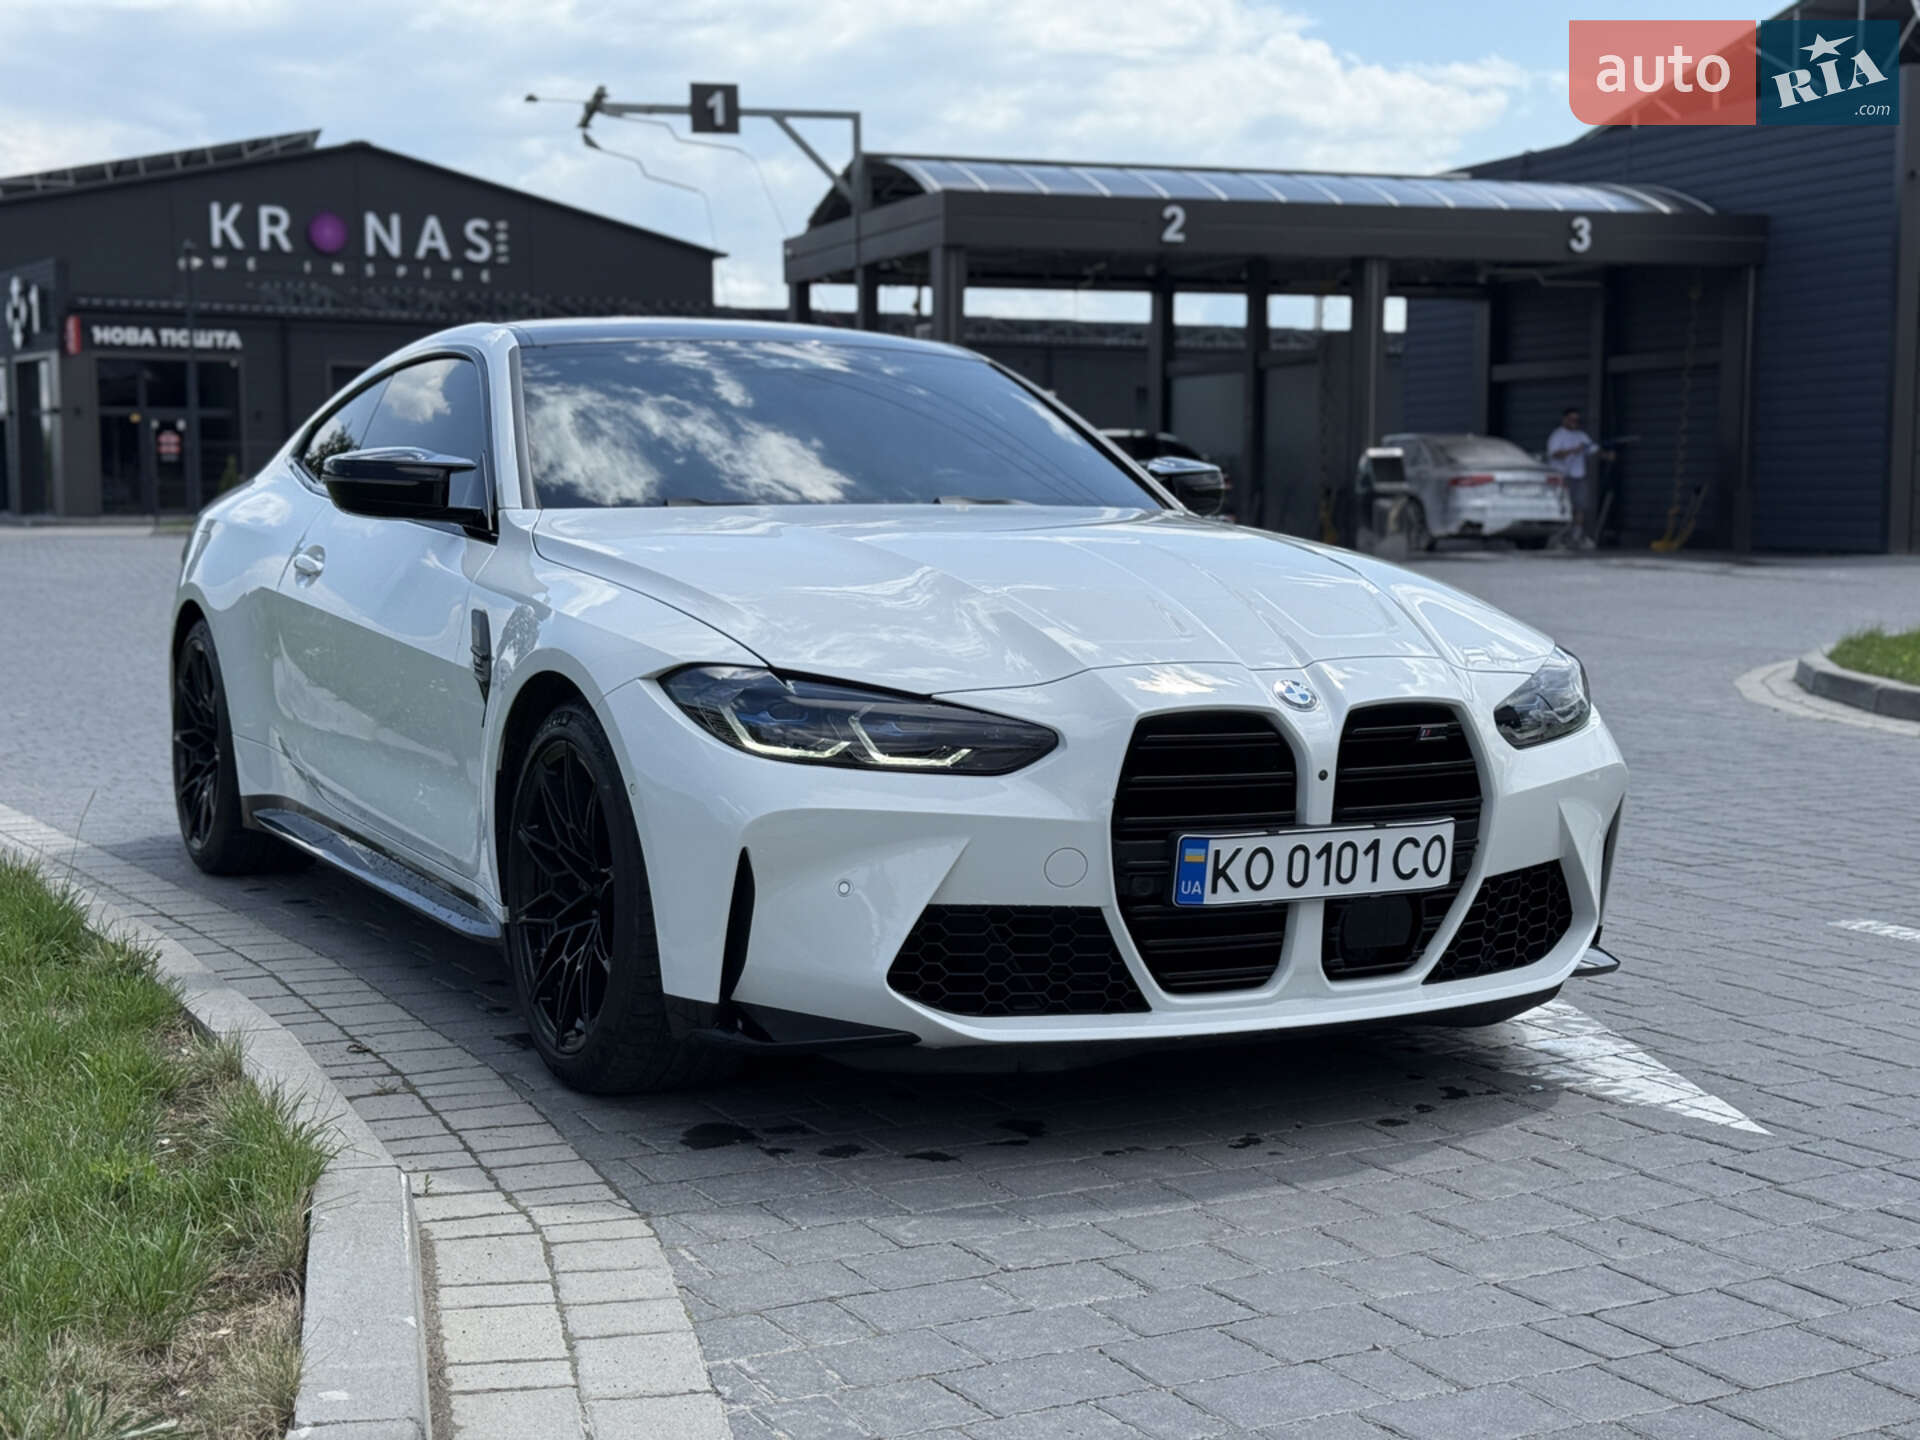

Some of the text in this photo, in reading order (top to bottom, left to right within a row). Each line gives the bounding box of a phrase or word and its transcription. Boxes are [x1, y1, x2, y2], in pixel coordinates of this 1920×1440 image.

[706, 90, 726, 127] 1
[208, 201, 493, 263] KRONAS
[1162, 204, 1186, 243] 2
[1570, 216, 1592, 253] 3
[91, 325, 156, 347] НОВА
[1210, 834, 1447, 895] KO 0101 CO
[1180, 880, 1203, 895] UA
